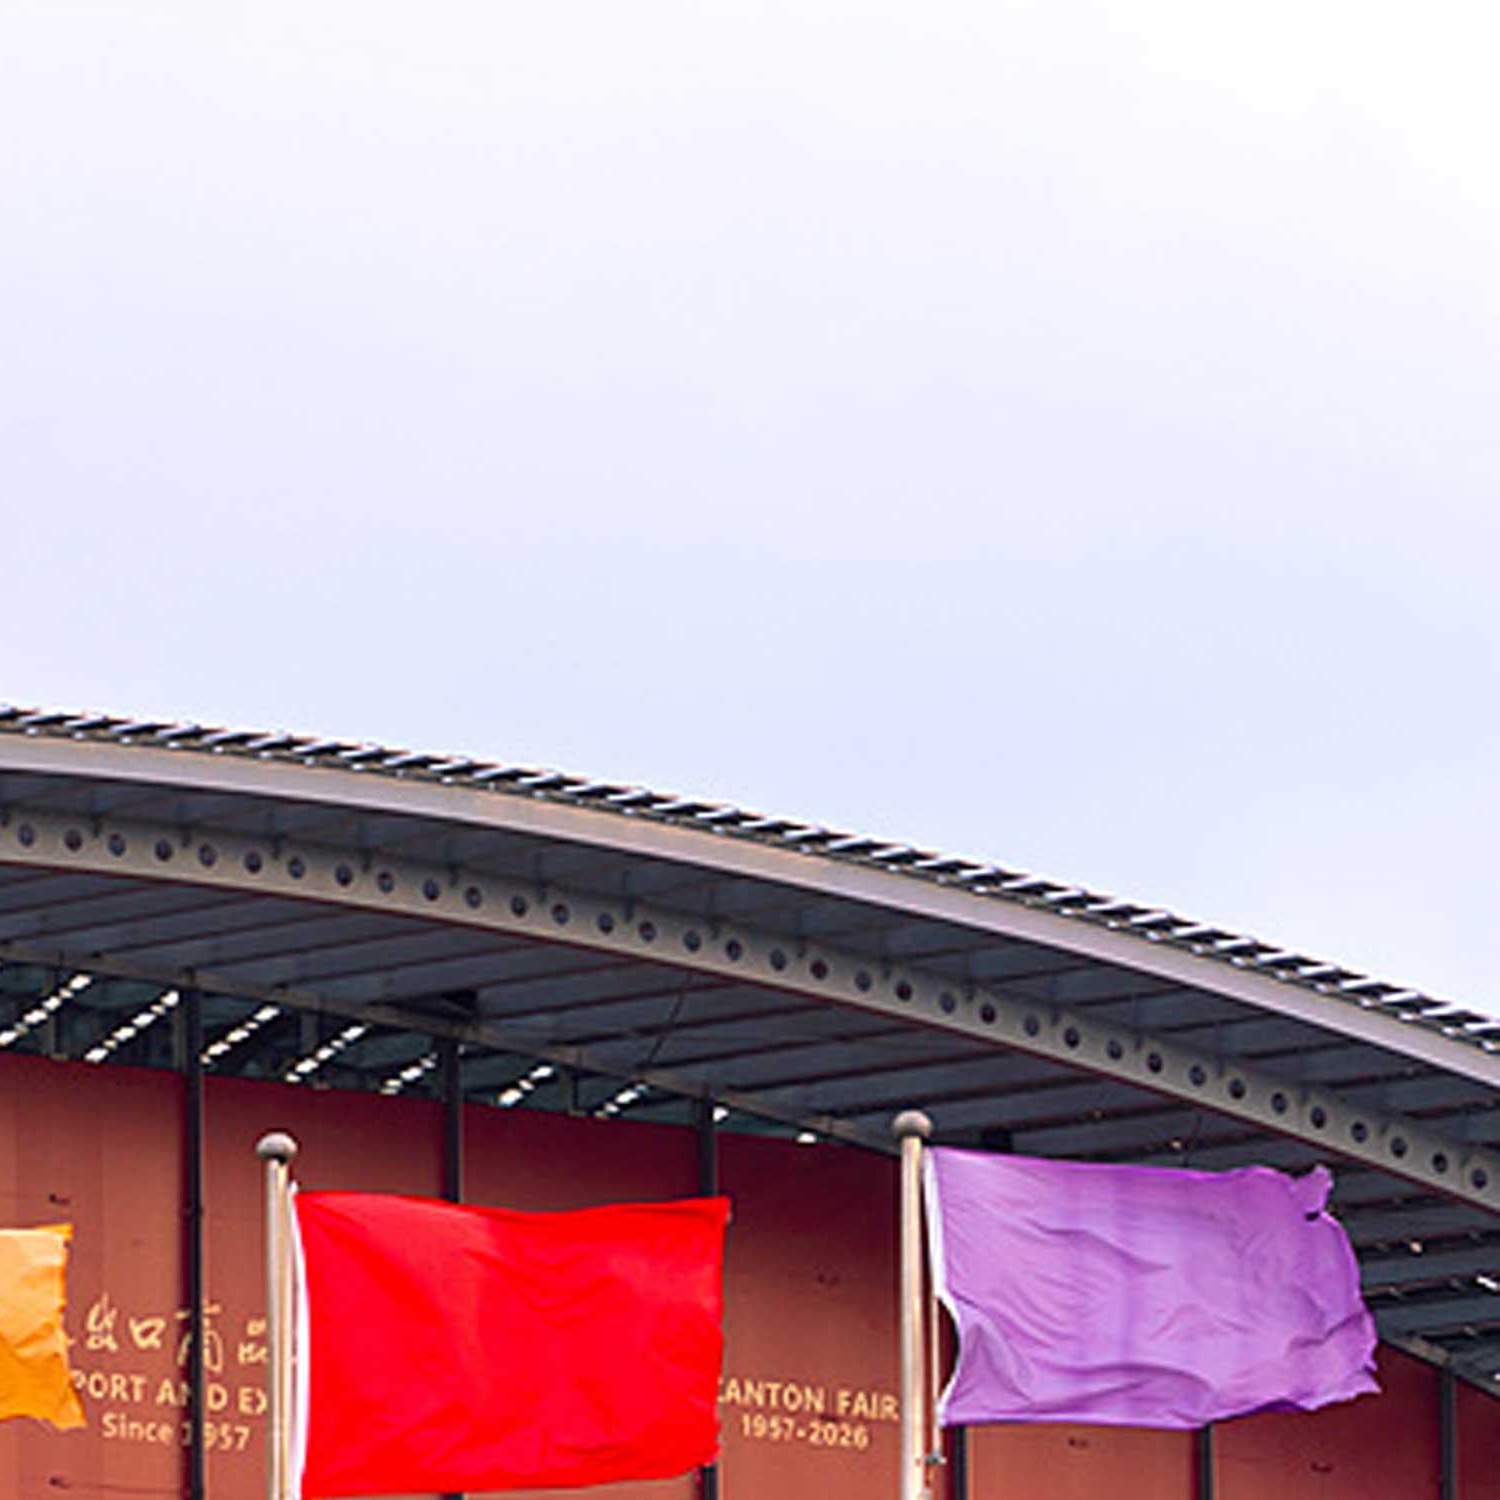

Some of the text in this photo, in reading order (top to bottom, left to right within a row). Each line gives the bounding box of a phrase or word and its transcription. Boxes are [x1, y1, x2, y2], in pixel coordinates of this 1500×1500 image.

[718, 1377, 900, 1421] ANTON FAIR
[102, 1412, 174, 1446] Since
